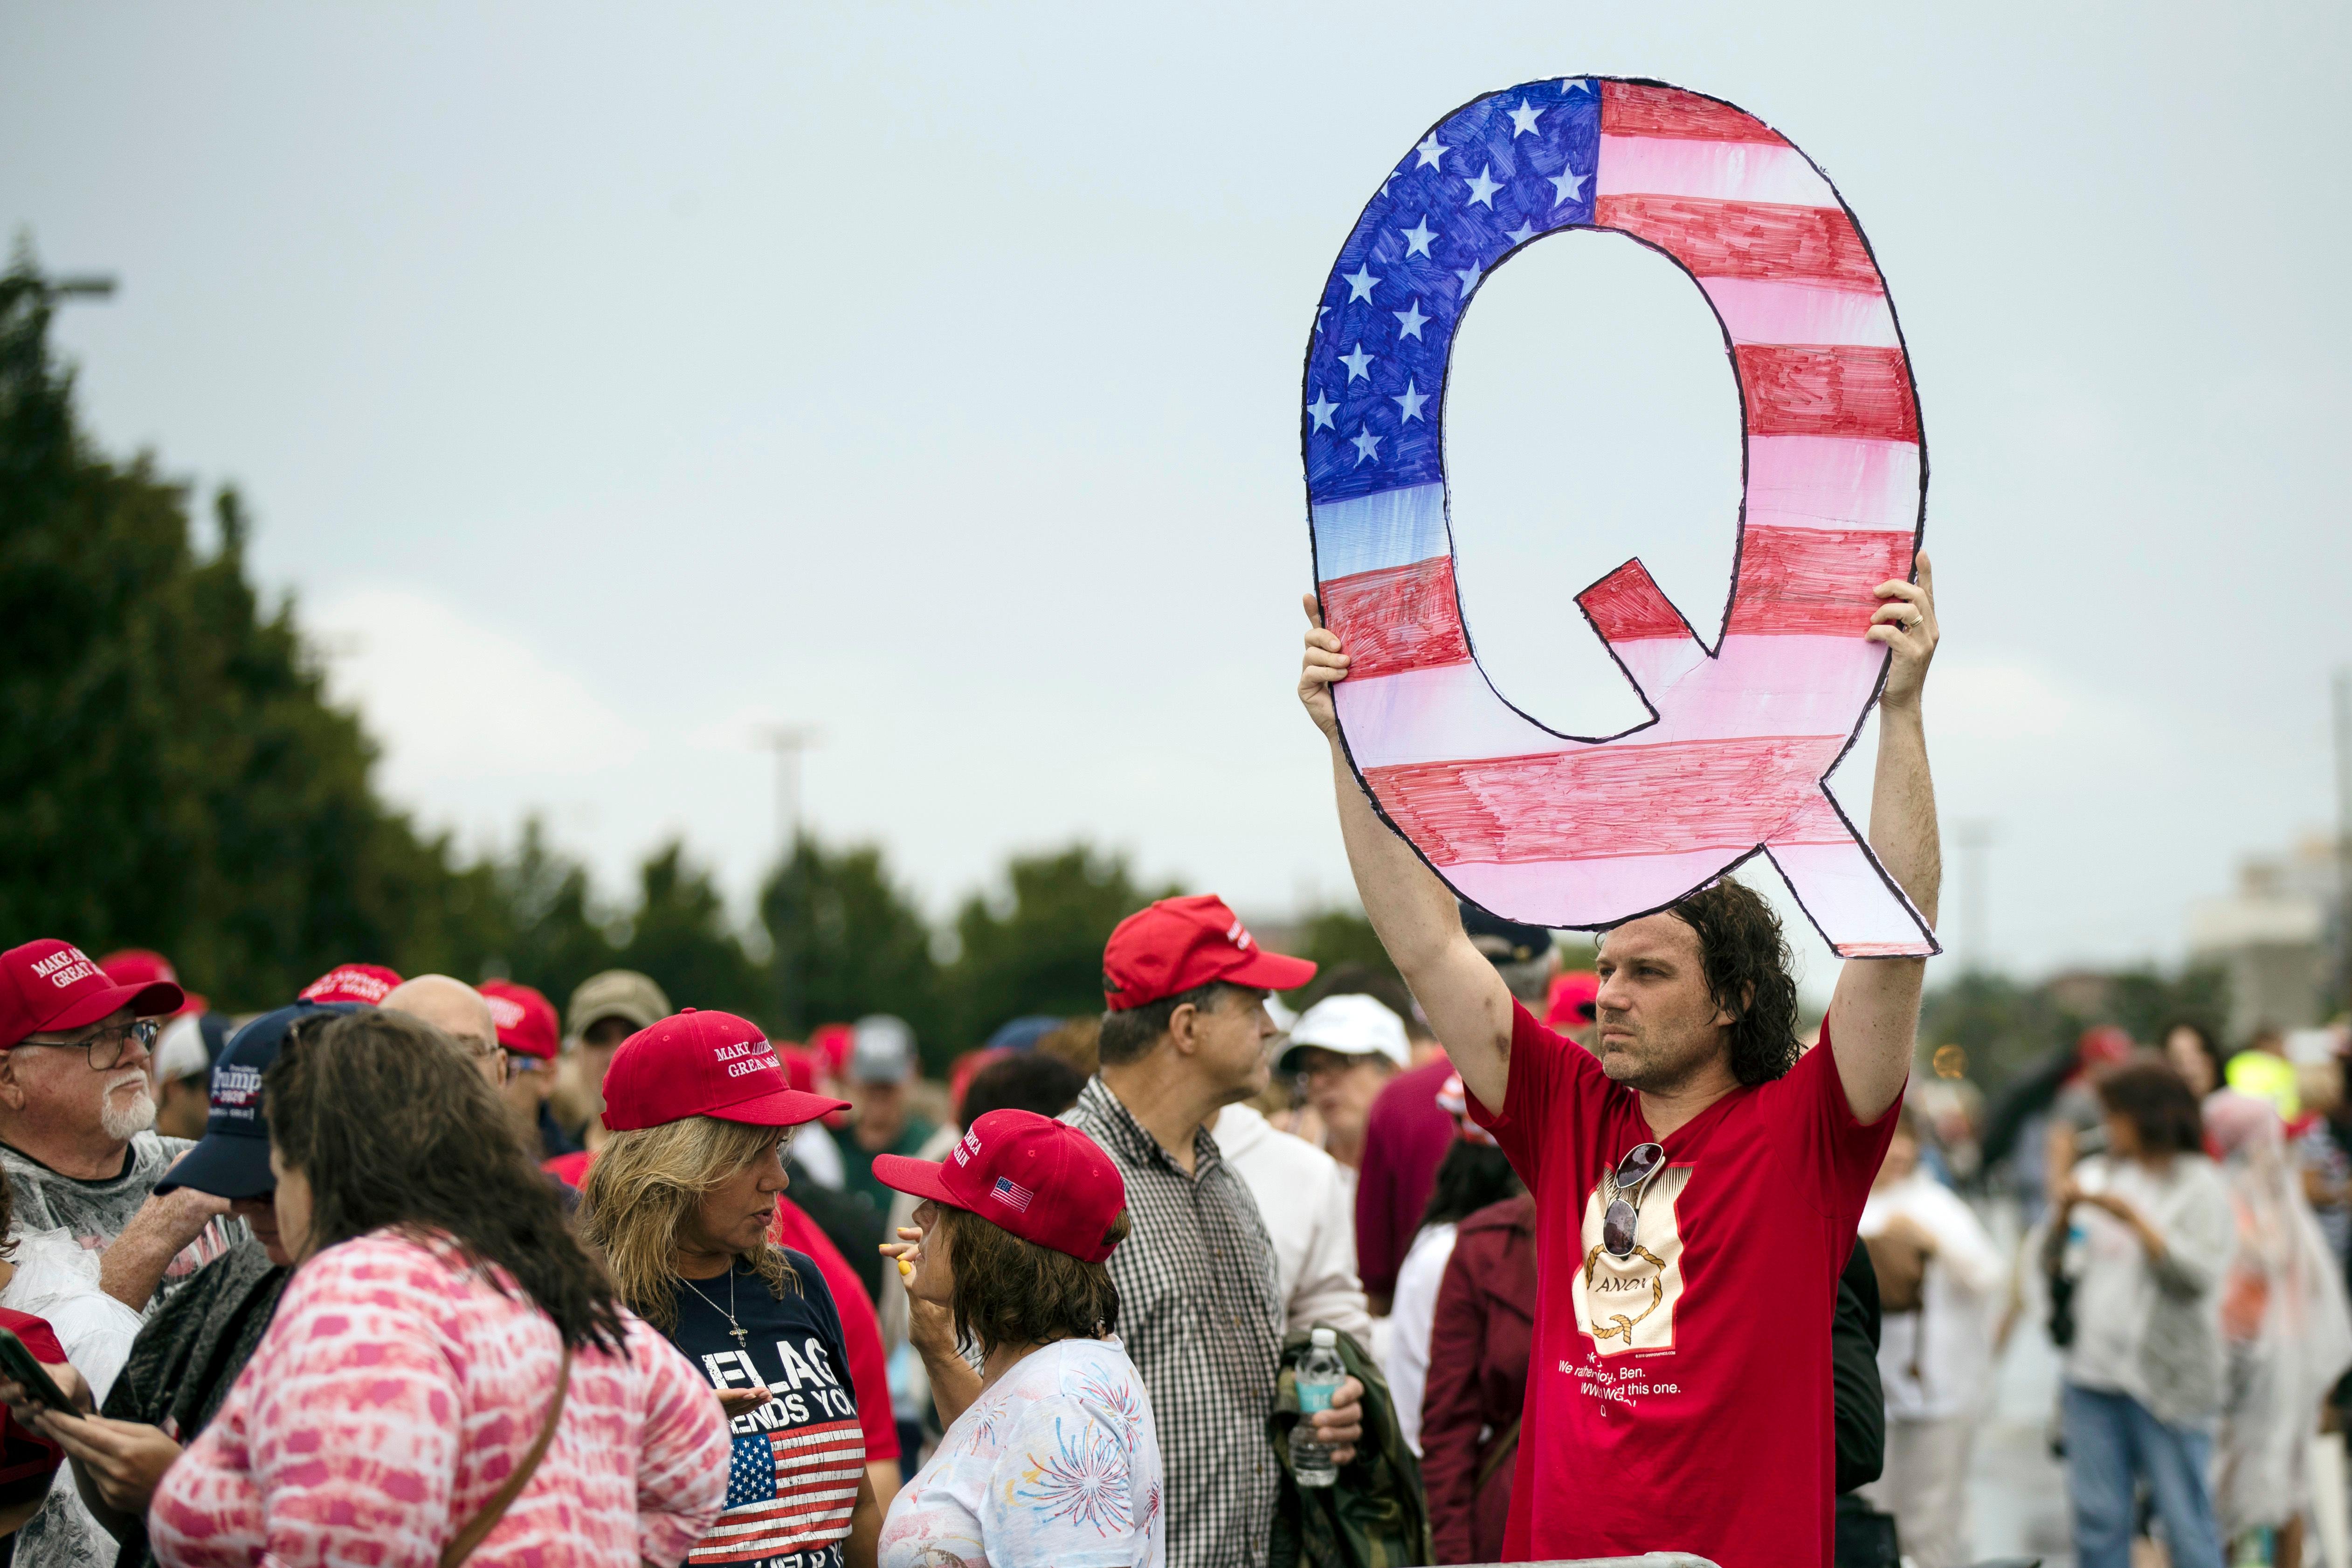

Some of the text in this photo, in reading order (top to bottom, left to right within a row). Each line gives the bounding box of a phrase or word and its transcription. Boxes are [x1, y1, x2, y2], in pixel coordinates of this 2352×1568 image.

[31, 950, 73, 979] MAKE
[52, 961, 93, 988] GREAT
[728, 1057, 767, 1078] GREA
[701, 1338, 839, 1395] FLAG
[1559, 1360, 1573, 1374] We
[1620, 1367, 1646, 1380] Ben.
[1628, 1382, 1649, 1395] this
[1653, 1383, 1681, 1394] one.
[1600, 1404, 1607, 1417] Q
